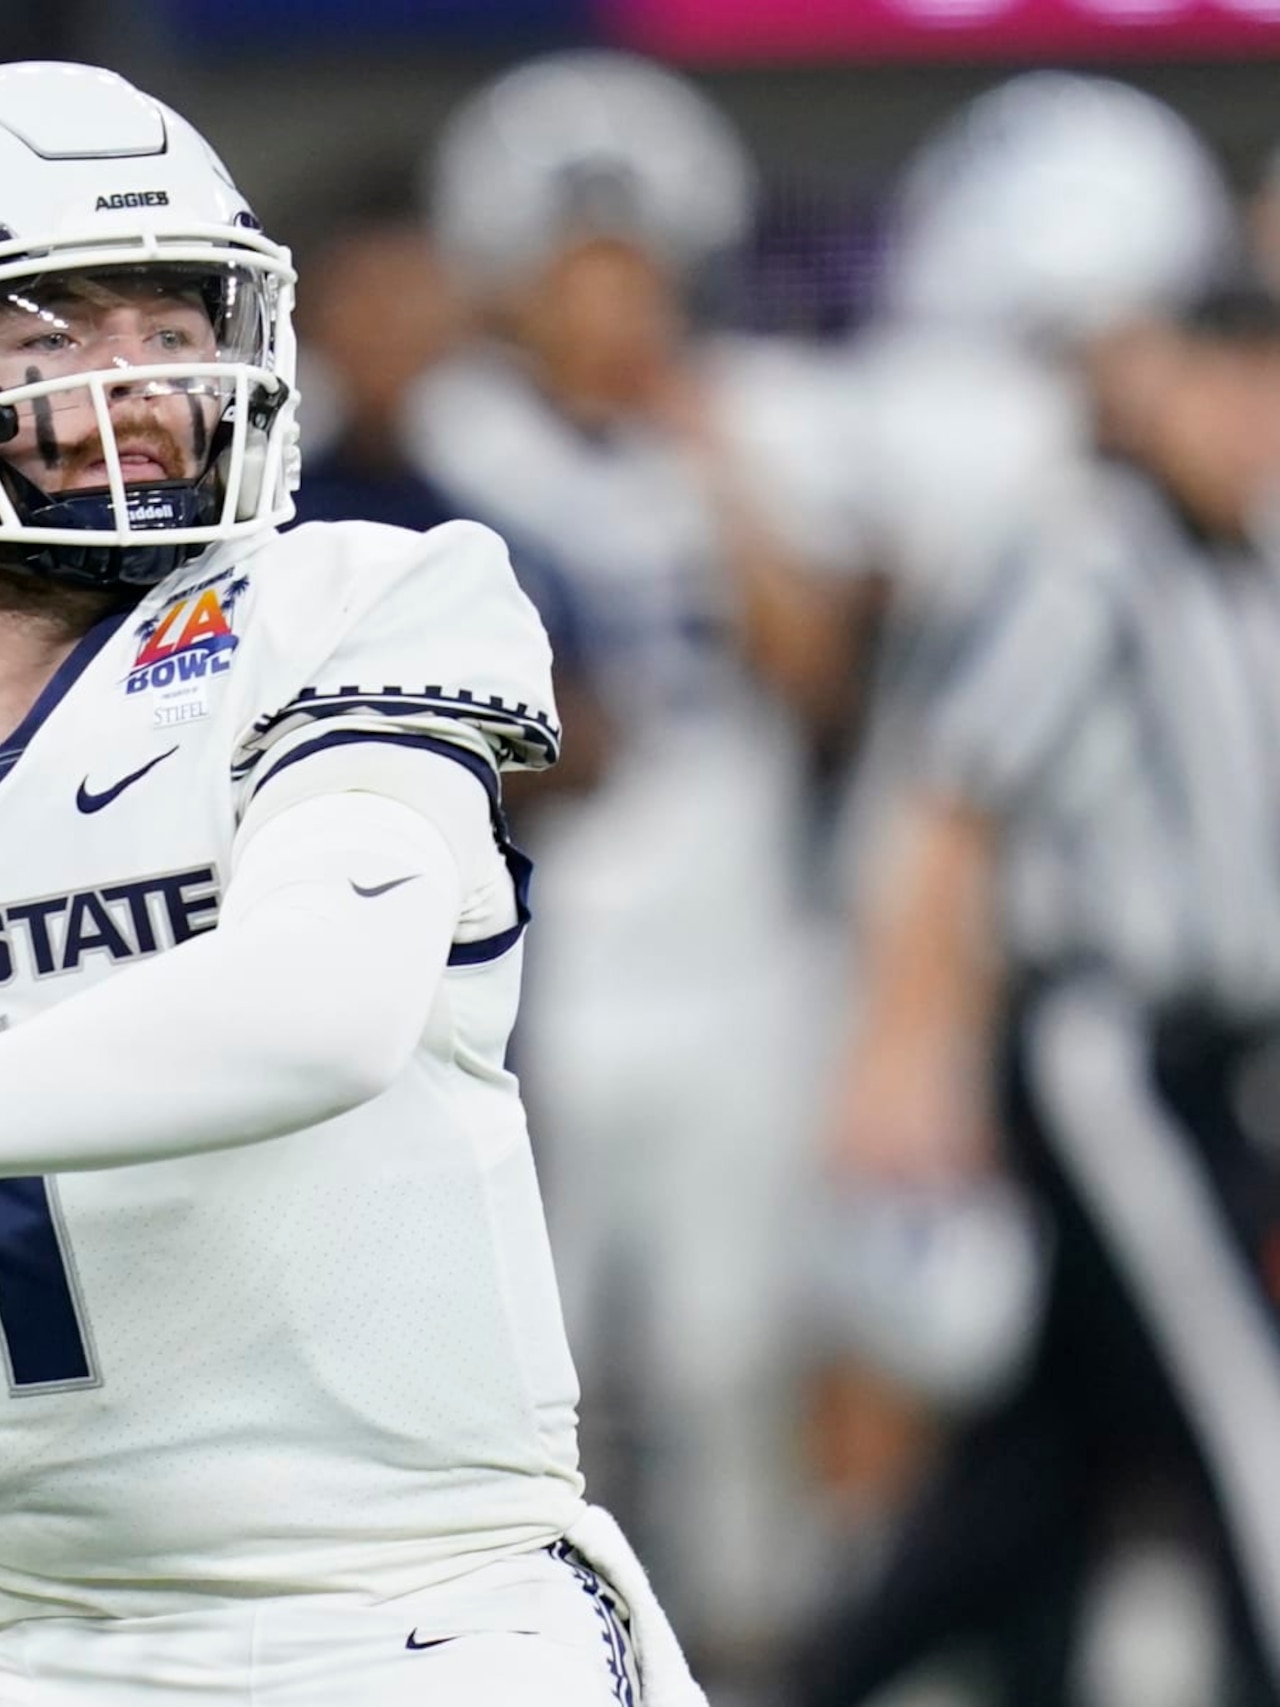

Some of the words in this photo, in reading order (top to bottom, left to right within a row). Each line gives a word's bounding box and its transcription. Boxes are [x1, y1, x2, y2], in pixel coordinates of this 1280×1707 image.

[95, 190, 170, 212] AGGIES
[128, 503, 174, 521] iddell
[133, 588, 233, 669] LA
[125, 650, 232, 695] BOWL
[153, 700, 209, 726] STIFEL
